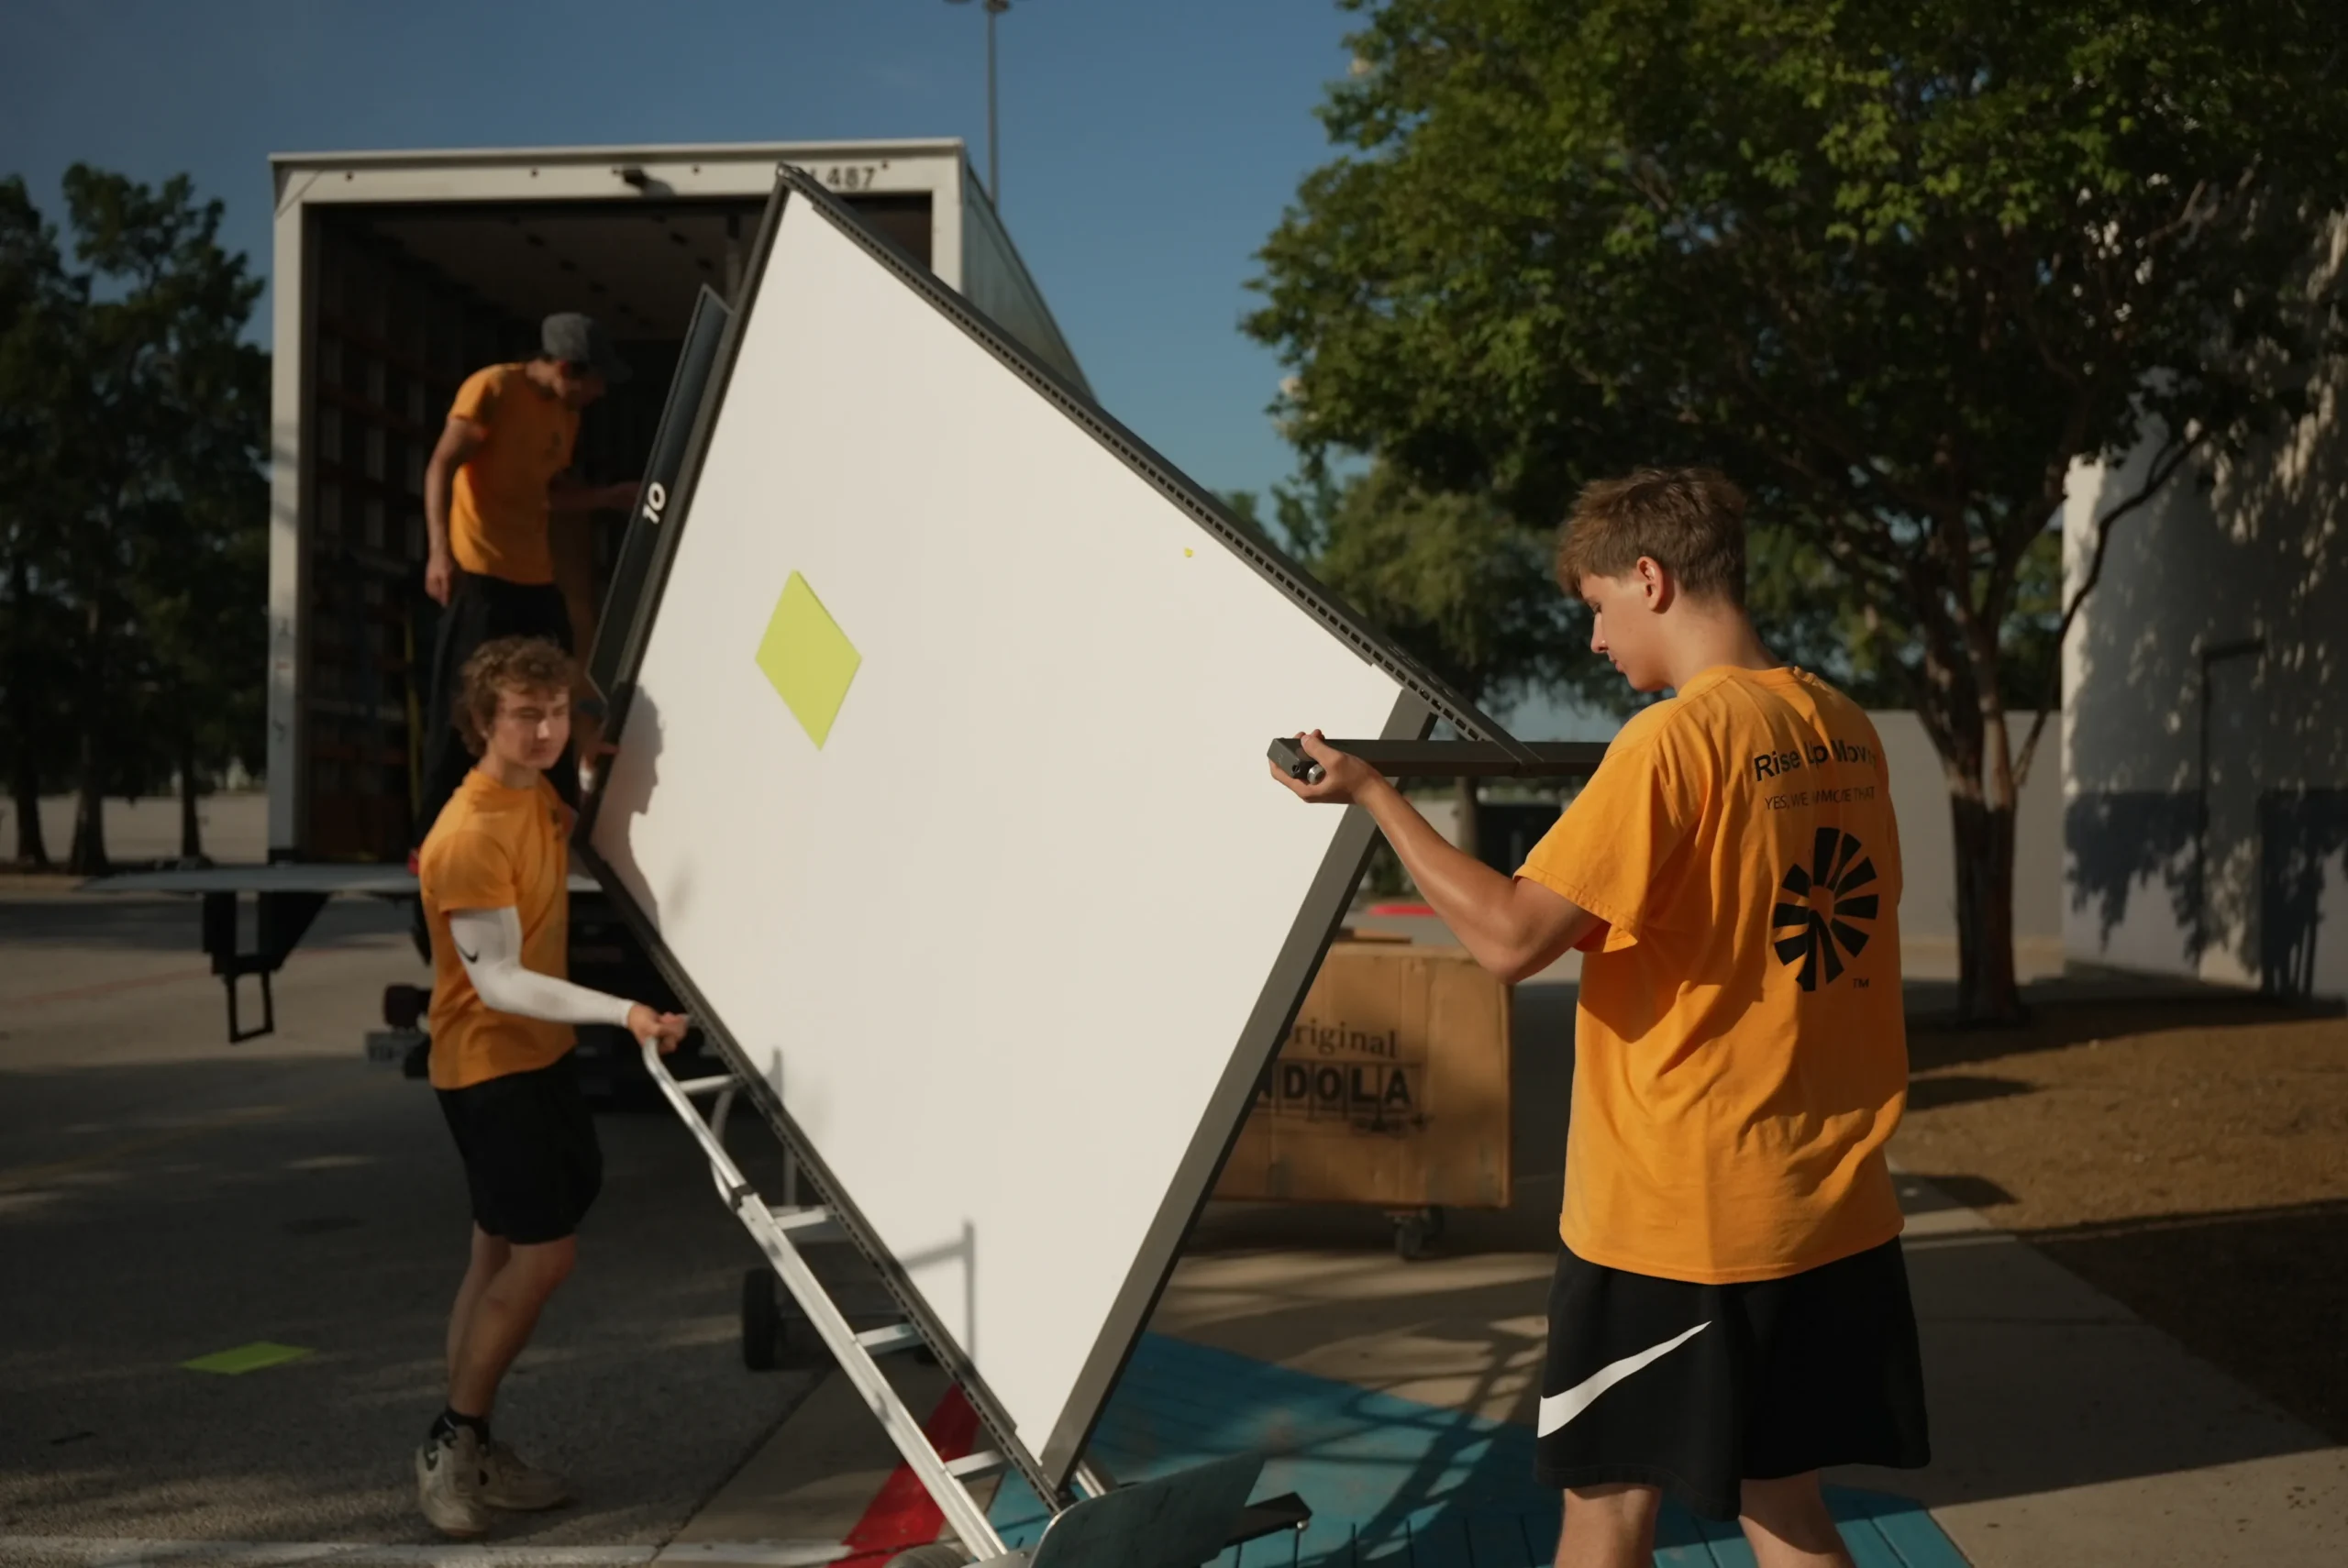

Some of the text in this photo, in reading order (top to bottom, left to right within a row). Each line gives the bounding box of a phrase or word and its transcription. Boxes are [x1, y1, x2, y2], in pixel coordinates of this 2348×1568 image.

[643, 481, 666, 525] 10
[1754, 748, 1800, 782] Rise
[1765, 794, 1789, 810] YES,
[1791, 791, 1810, 808] WE
[1853, 785, 1876, 802] THAT
[1289, 1017, 1396, 1059] riginal
